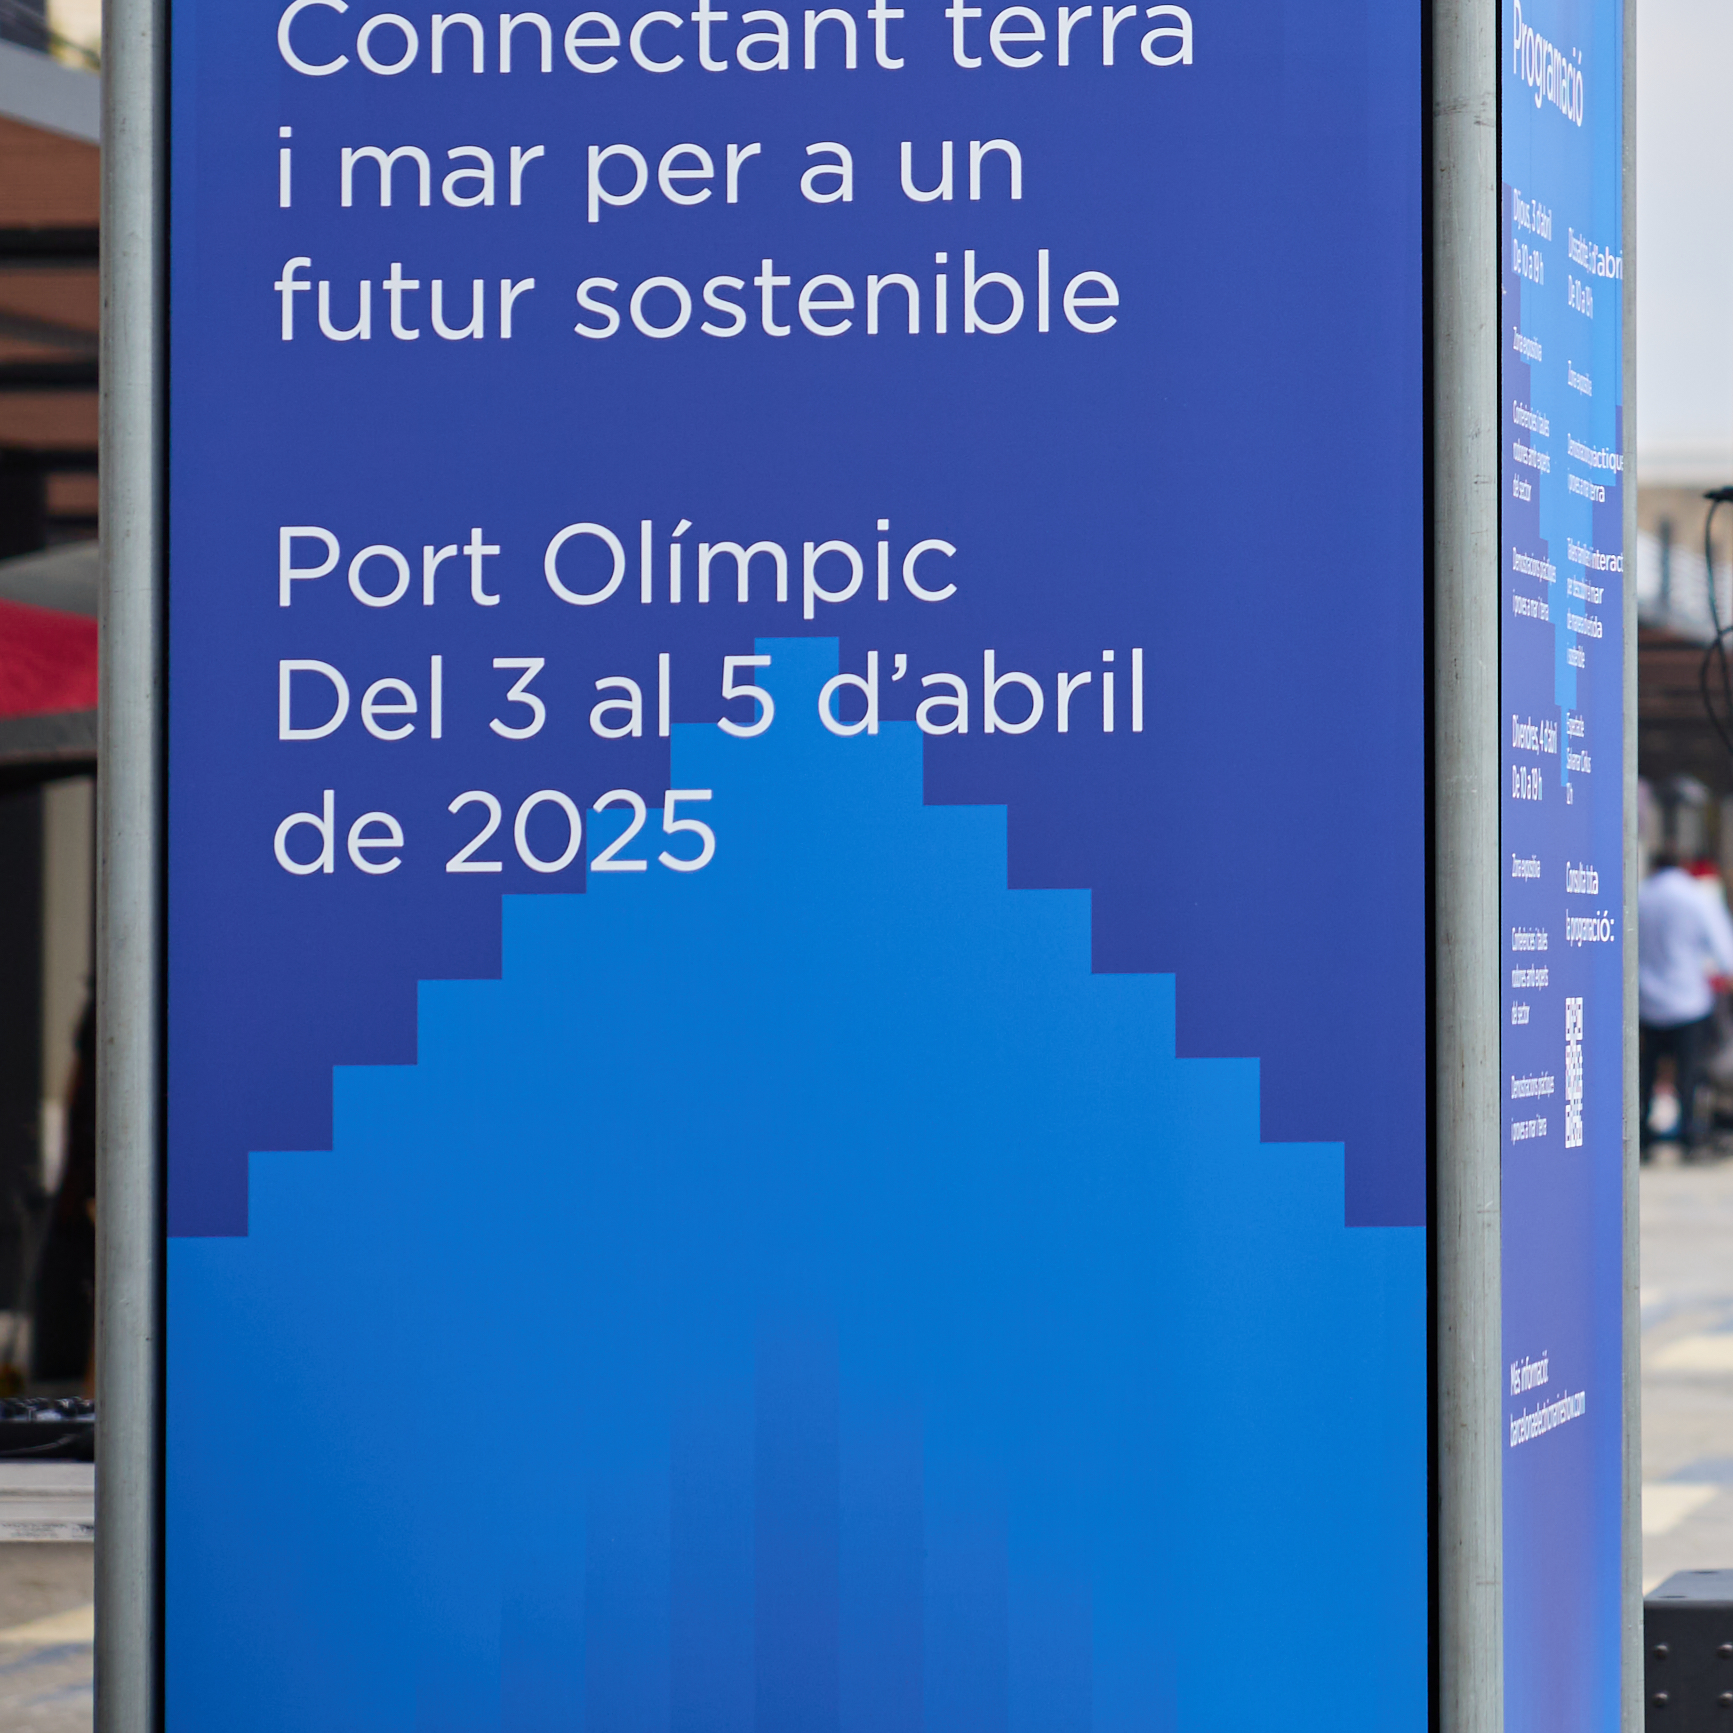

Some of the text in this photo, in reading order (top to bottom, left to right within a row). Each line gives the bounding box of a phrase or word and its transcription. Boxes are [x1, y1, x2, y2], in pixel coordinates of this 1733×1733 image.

[280, 126, 1022, 222] i mar per a un
[274, 249, 1119, 341] futur sostenible
[280, 519, 957, 619] Port Olímpic
[279, 648, 1142, 740] Del 3 al 5 d'abril
[274, 789, 715, 874] de 2025
